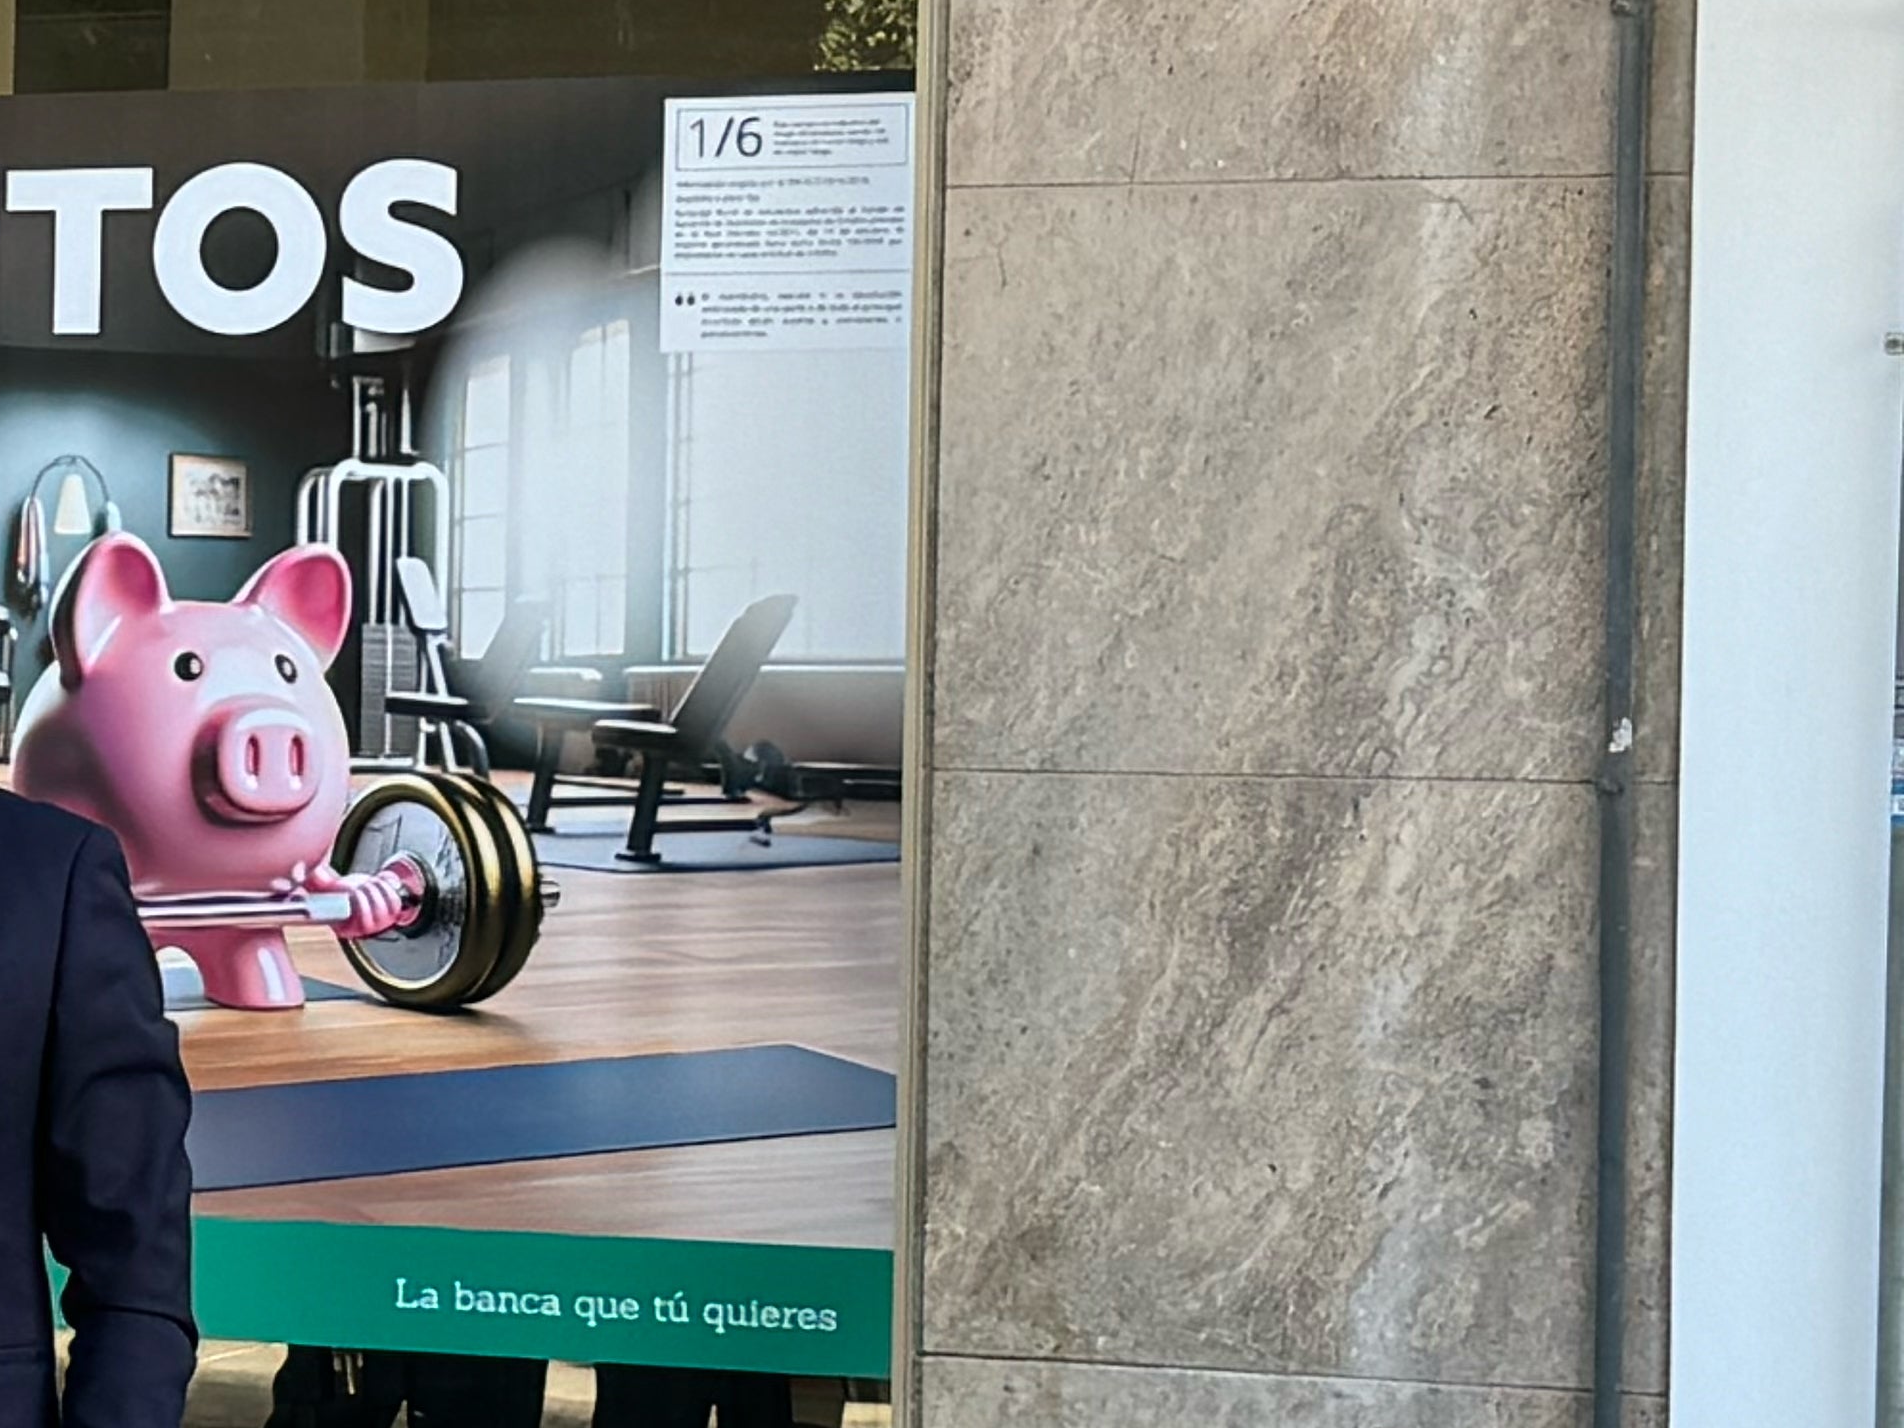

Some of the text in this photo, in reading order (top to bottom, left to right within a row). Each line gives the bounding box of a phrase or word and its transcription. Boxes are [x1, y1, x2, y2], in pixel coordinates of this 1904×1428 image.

[689, 116, 764, 159] 1/6
[395, 1278, 839, 1334] La banca que tú quieres
